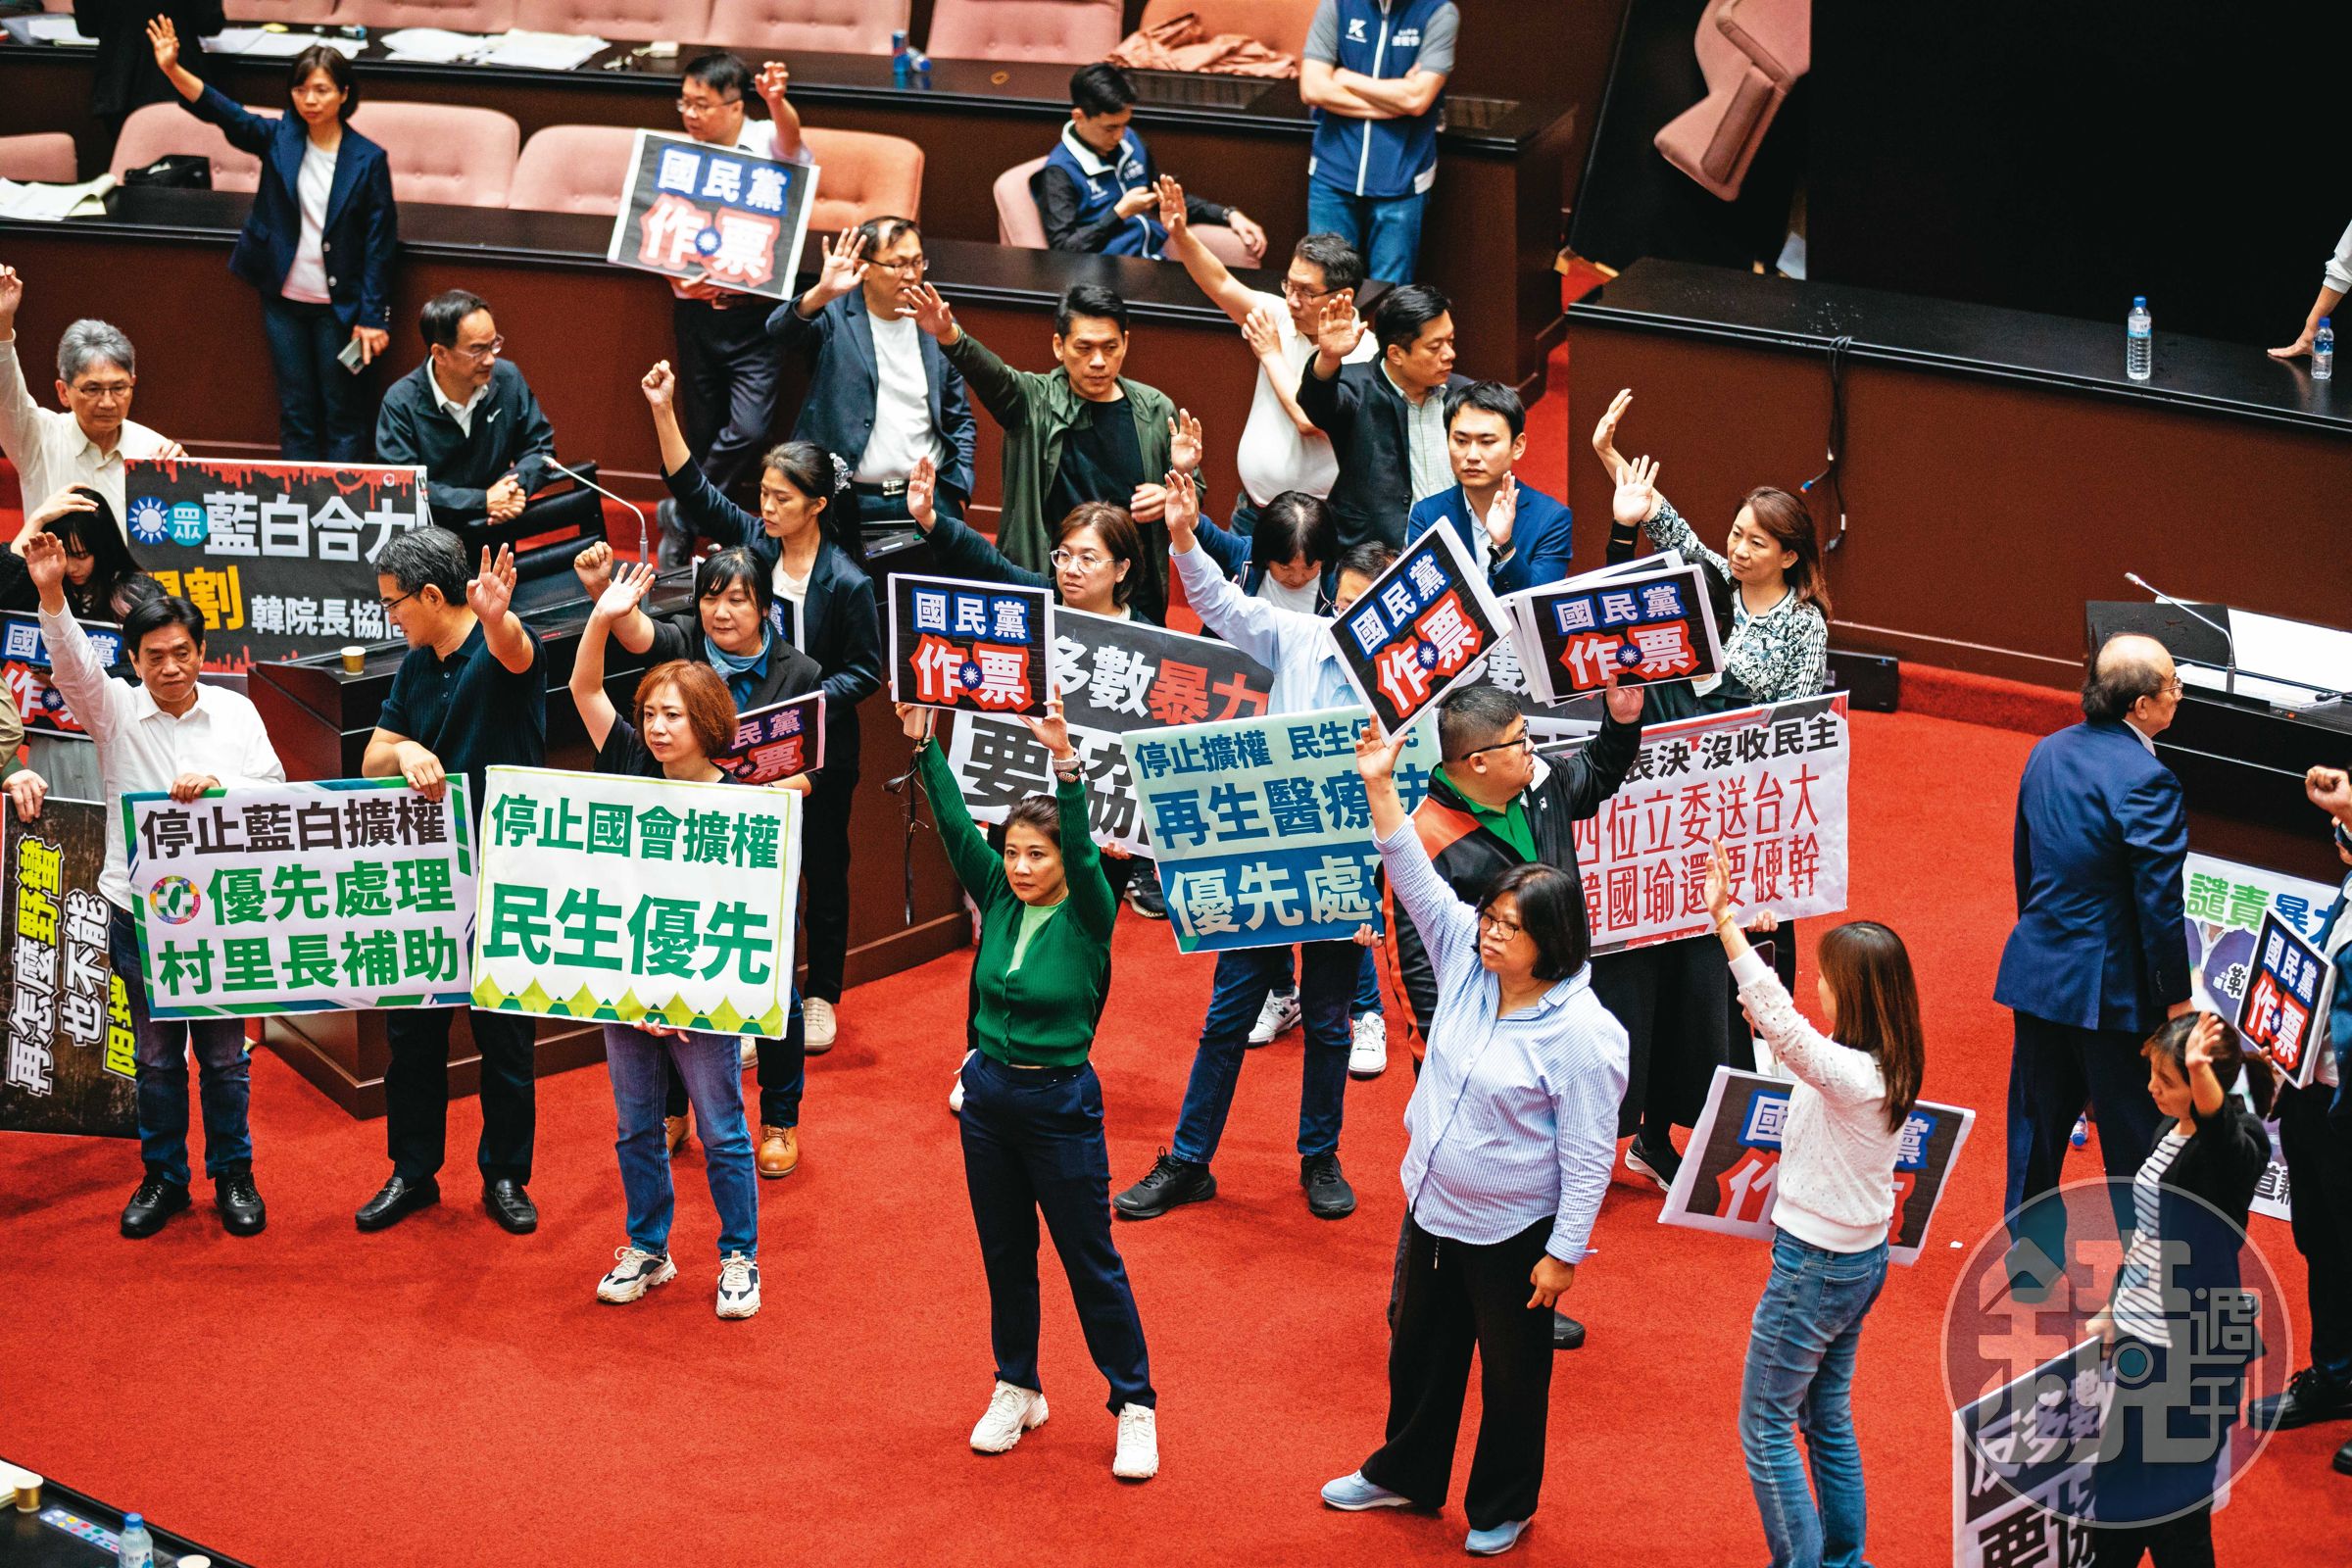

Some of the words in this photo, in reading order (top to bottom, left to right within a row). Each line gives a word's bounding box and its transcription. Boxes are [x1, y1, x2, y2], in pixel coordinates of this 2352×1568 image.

[658, 148, 788, 212] 國民黨
[647, 202, 774, 278] 作票
[915, 591, 1026, 640] 國民黨
[1350, 554, 1446, 656] 國民黨
[1556, 585, 1682, 634] 國民黨
[5, 623, 119, 667] 國黨
[917, 642, 1026, 706] 作票
[1382, 598, 1477, 711] 作票
[1568, 625, 1690, 685] 作票
[712, 740, 801, 780] 票
[1135, 729, 1274, 780] 停止擴權
[1287, 717, 1419, 761] 民生
[1701, 716, 1839, 770] 沒收民主
[141, 796, 448, 859] 停止藍白擴權
[492, 793, 781, 869] 停止國會擴權
[207, 858, 457, 926] 優先處理
[1167, 853, 1384, 938] 優先處
[9, 835, 64, 1094] 再怎麼野蠻
[63, 888, 110, 1047] 也不能
[157, 926, 460, 997] 村里長補助
[482, 882, 773, 986] 民生優先
[2263, 929, 2317, 1002] 國民黨
[2248, 979, 2305, 1064] 作票
[1745, 1096, 1931, 1164] 國黨
